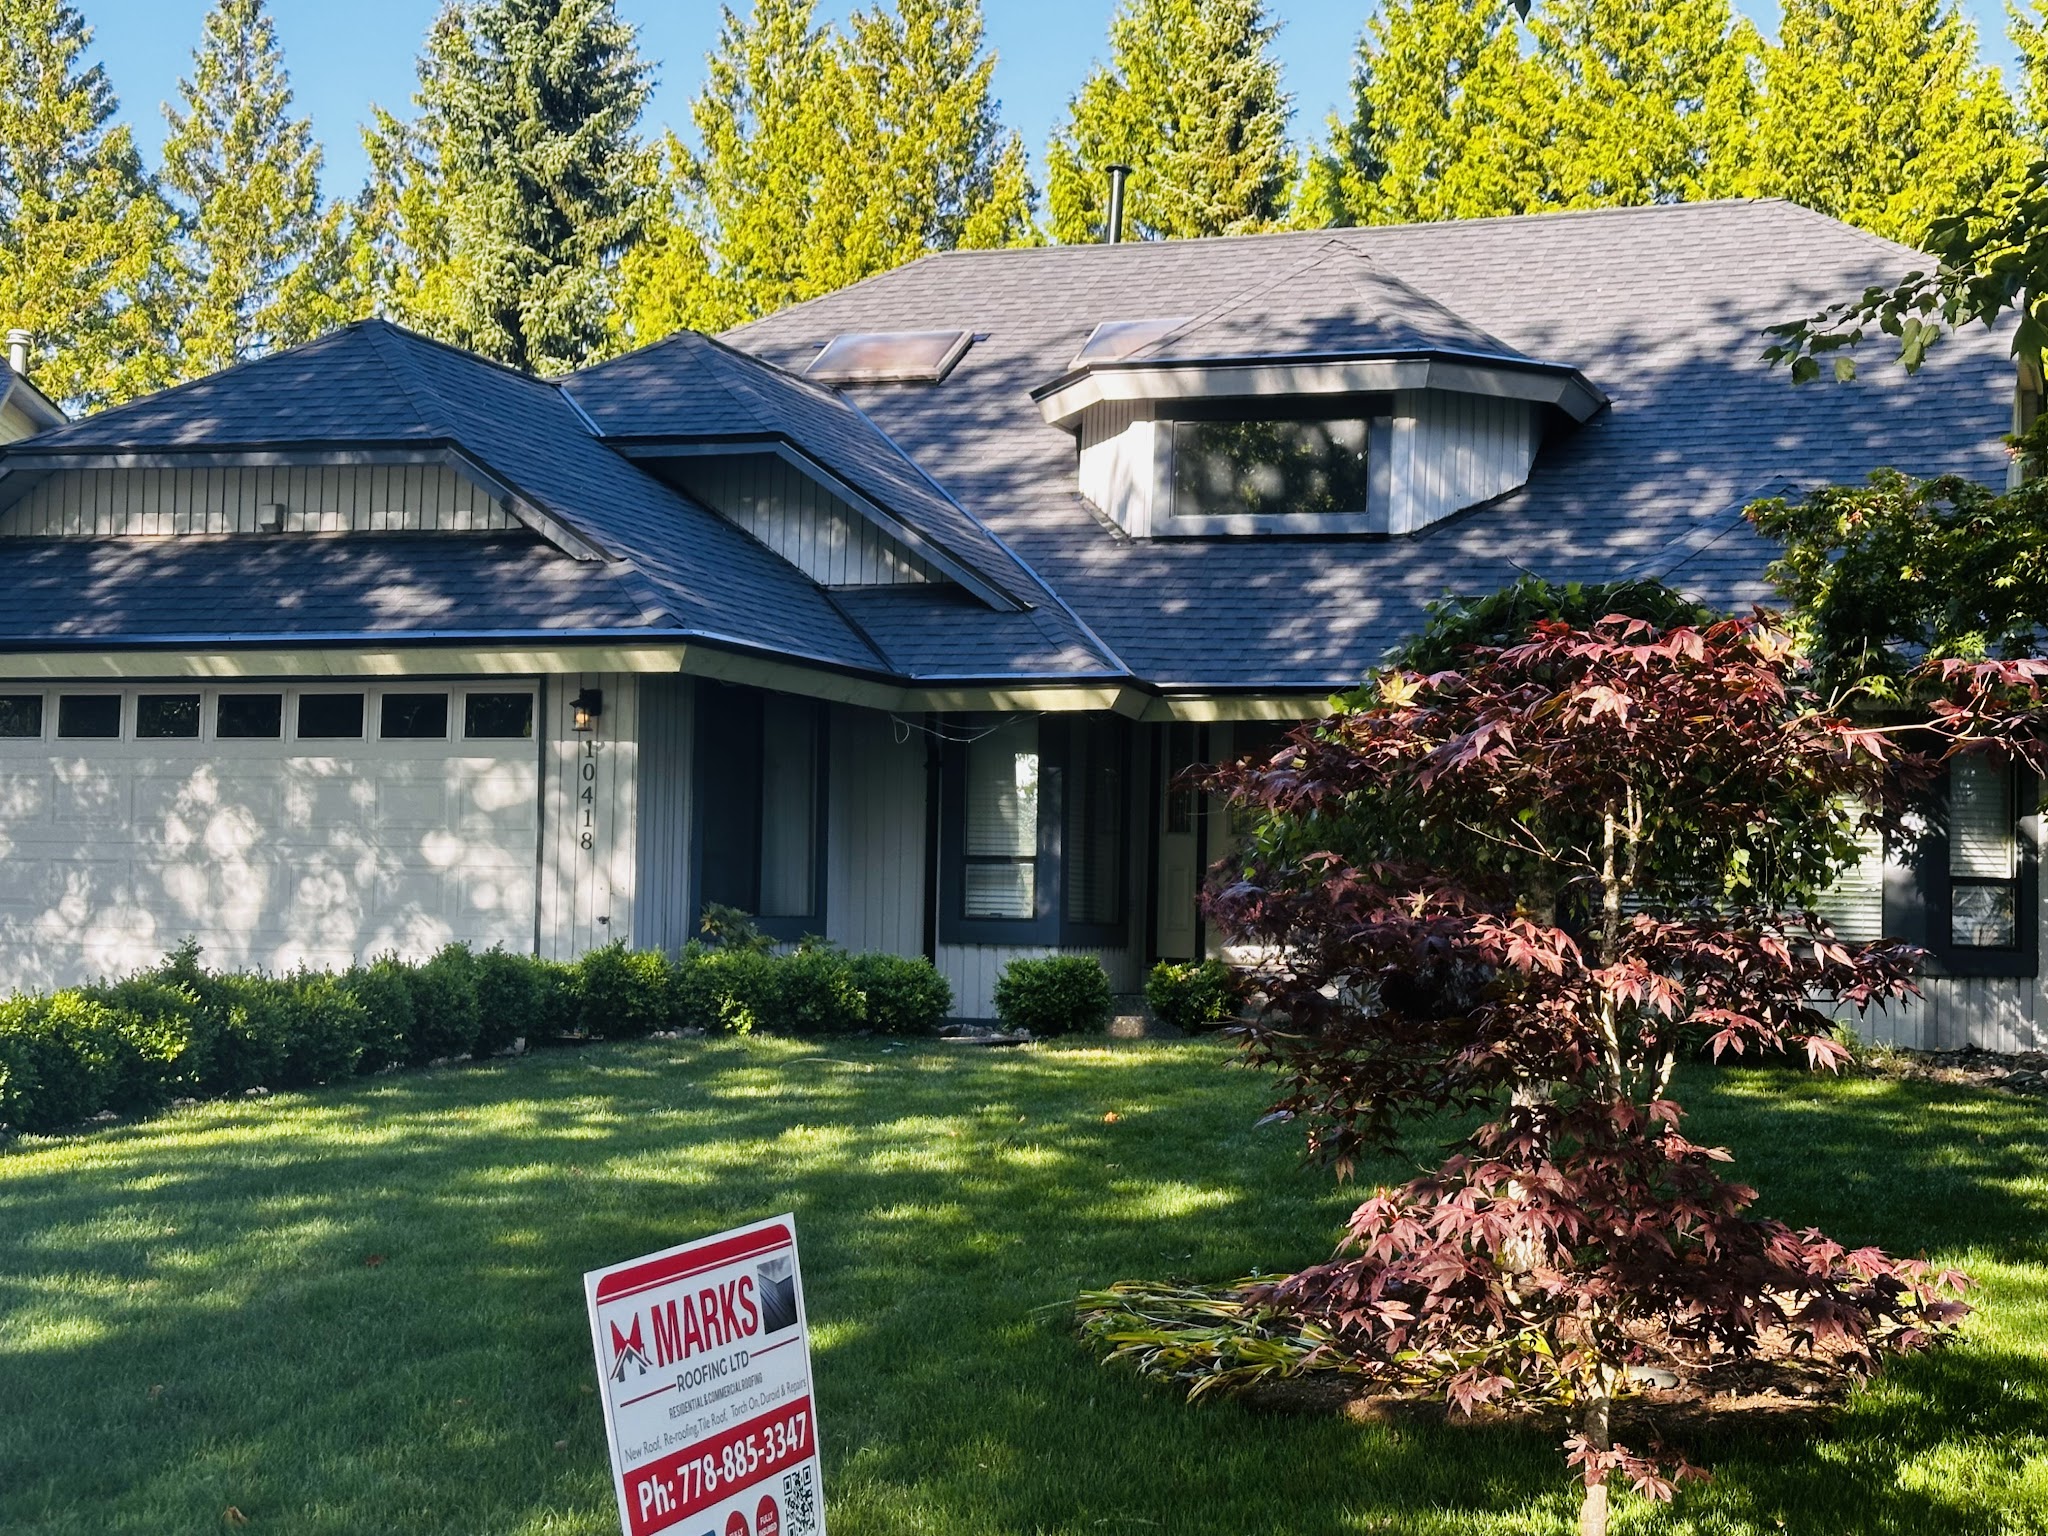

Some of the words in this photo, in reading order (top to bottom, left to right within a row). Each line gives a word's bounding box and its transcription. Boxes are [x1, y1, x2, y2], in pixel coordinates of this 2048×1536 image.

[580, 740, 595, 850] 10418
[651, 1275, 758, 1368] MARKS
[669, 1396, 704, 1419] RESIDENTIAL
[703, 1393, 709, 1406] &
[708, 1380, 742, 1404] COMMERCIAL
[741, 1372, 763, 1392] ROOFING
[676, 1358, 728, 1392] ROOFING
[730, 1352, 749, 1373] LTD
[625, 1445, 642, 1462] New
[697, 1416, 711, 1432] Tile
[730, 1400, 748, 1418] Torch
[780, 1384, 786, 1397] &
[786, 1378, 807, 1395] Repairs
[638, 1474, 676, 1523] Ph:
[677, 1411, 807, 1505] 778-885-3347
